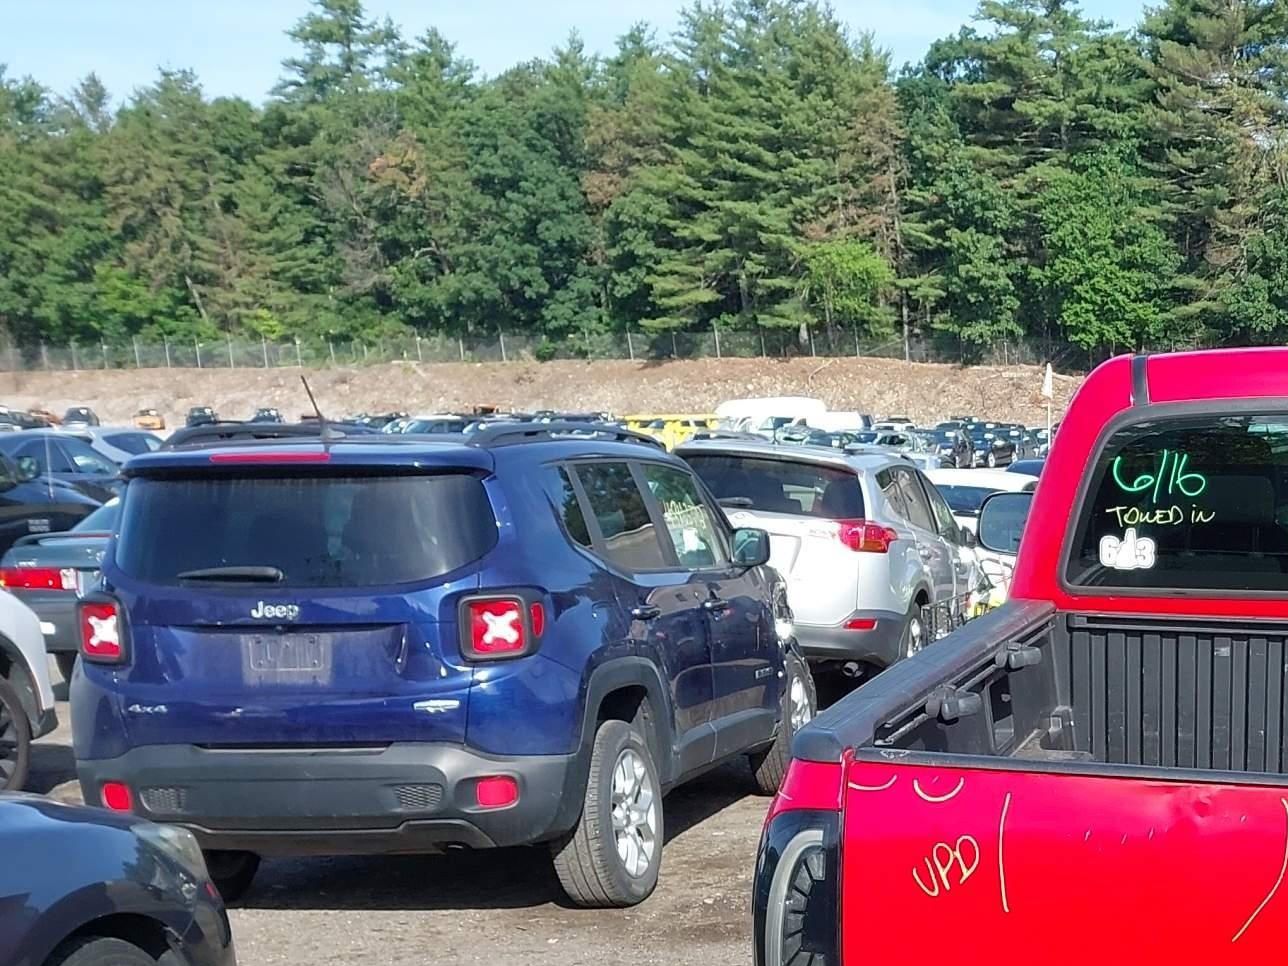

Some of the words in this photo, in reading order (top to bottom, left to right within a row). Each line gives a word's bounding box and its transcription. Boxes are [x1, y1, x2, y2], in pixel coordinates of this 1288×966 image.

[1113, 449, 1206, 503] 6/16
[1105, 505, 1184, 528] TOWED
[250, 600, 300, 620] Jeep
[912, 834, 980, 897] UPD
